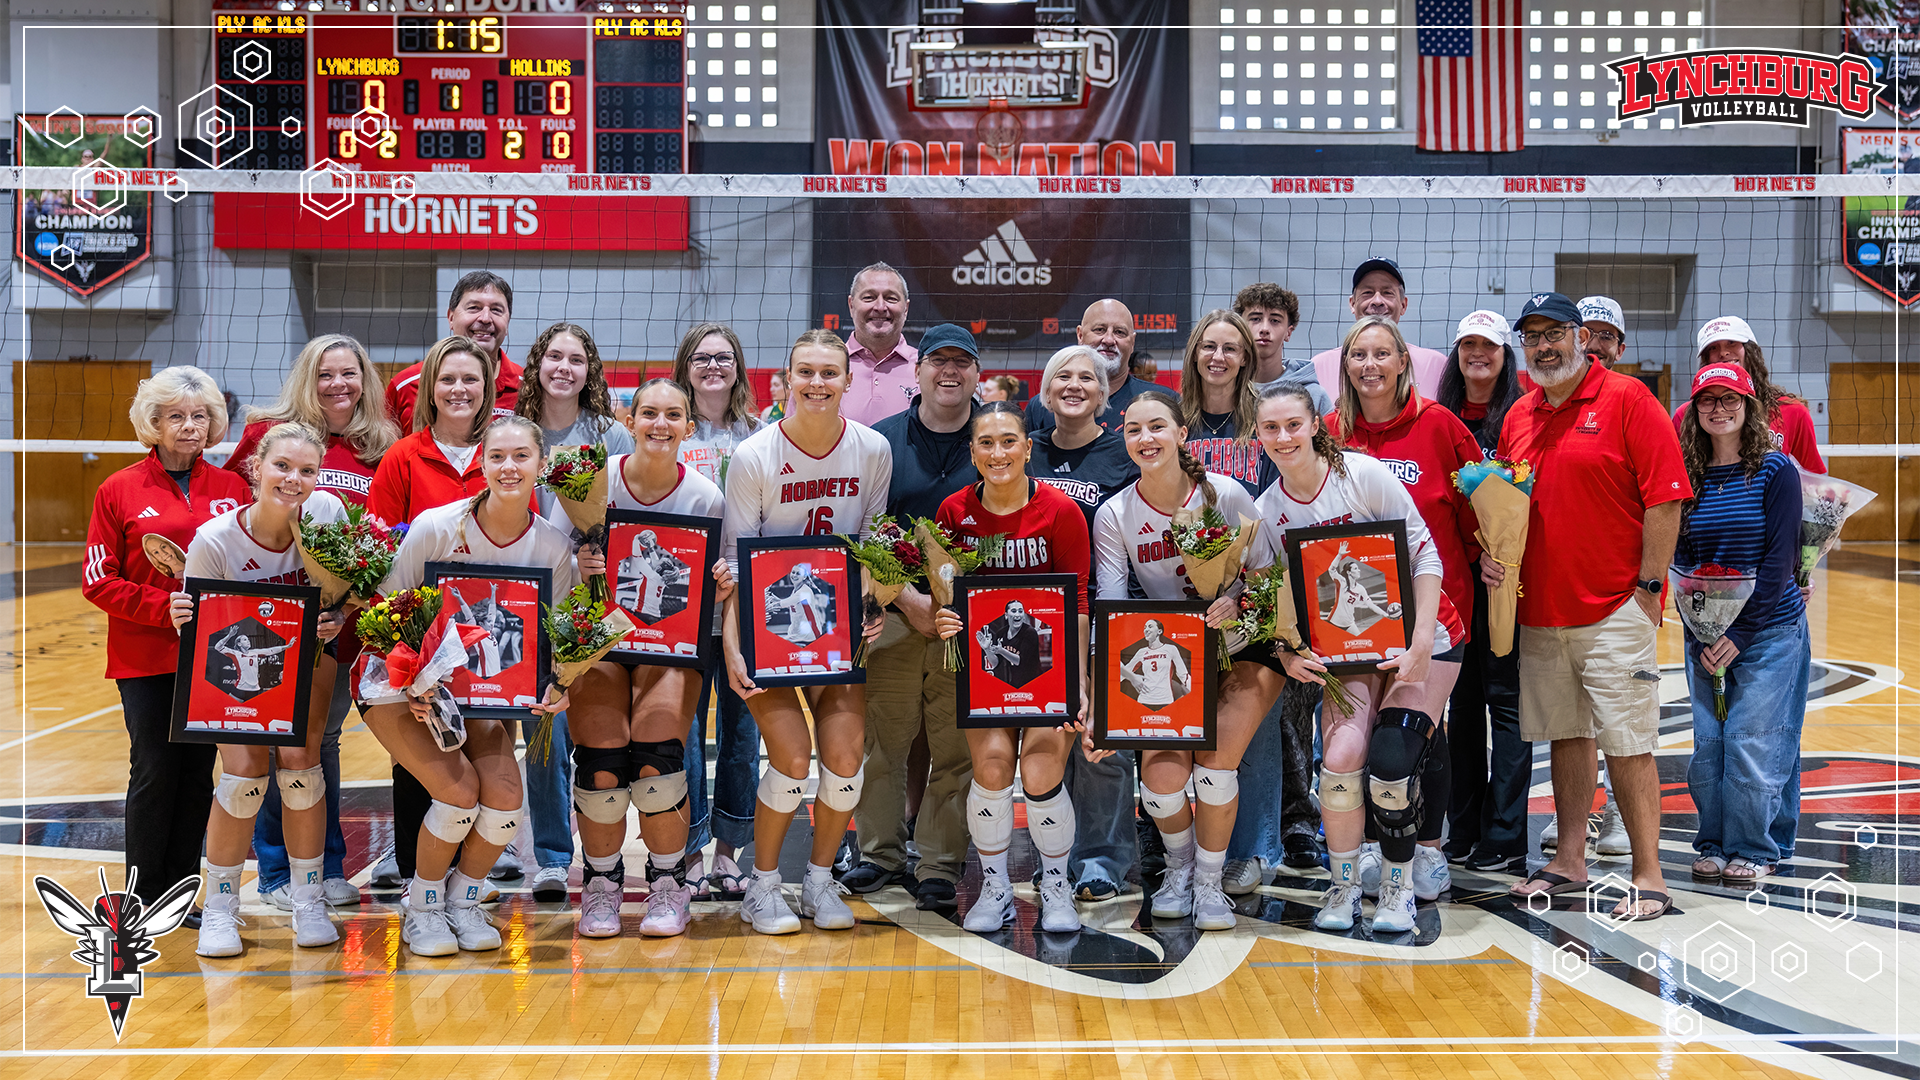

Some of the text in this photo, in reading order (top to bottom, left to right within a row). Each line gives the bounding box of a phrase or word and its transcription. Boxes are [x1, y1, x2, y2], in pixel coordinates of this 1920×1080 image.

[217, 15, 305, 33] PLY AC KLS
[595, 18, 682, 36] PLY AC KLS
[437, 17, 501, 52] 1:15
[317, 58, 400, 76] LYNCHBURG
[431, 68, 471, 80] PERIOD
[510, 59, 571, 77] HOLLINS
[364, 79, 385, 115] 0
[549, 80, 571, 115] 0
[413, 118, 488, 130] PLAYER FOUL
[498, 118, 528, 130] T.O.L.
[541, 118, 576, 131] FOULS
[339, 130, 357, 158] 0
[378, 130, 397, 158] 2
[504, 131, 523, 159] 2
[552, 131, 571, 159] 0
[1860, 135, 1909, 146] MENS
[827, 138, 1177, 176] WON NATION
[93, 170, 179, 186] HORNETS
[331, 173, 416, 189] HORNETS
[567, 174, 652, 191] HORNETS
[802, 176, 888, 193] HORNETS
[1037, 176, 1122, 193] HORNETS
[1271, 177, 1355, 193] HORNETS
[1504, 177, 1587, 193] HORNETS
[1734, 176, 1817, 192] HORNETS
[35, 214, 133, 229] CHAMPION
[364, 197, 539, 236] HORNETS
[951, 259, 1052, 286] adidas
[780, 477, 860, 504] HORNETS
[803, 505, 834, 537] 16
